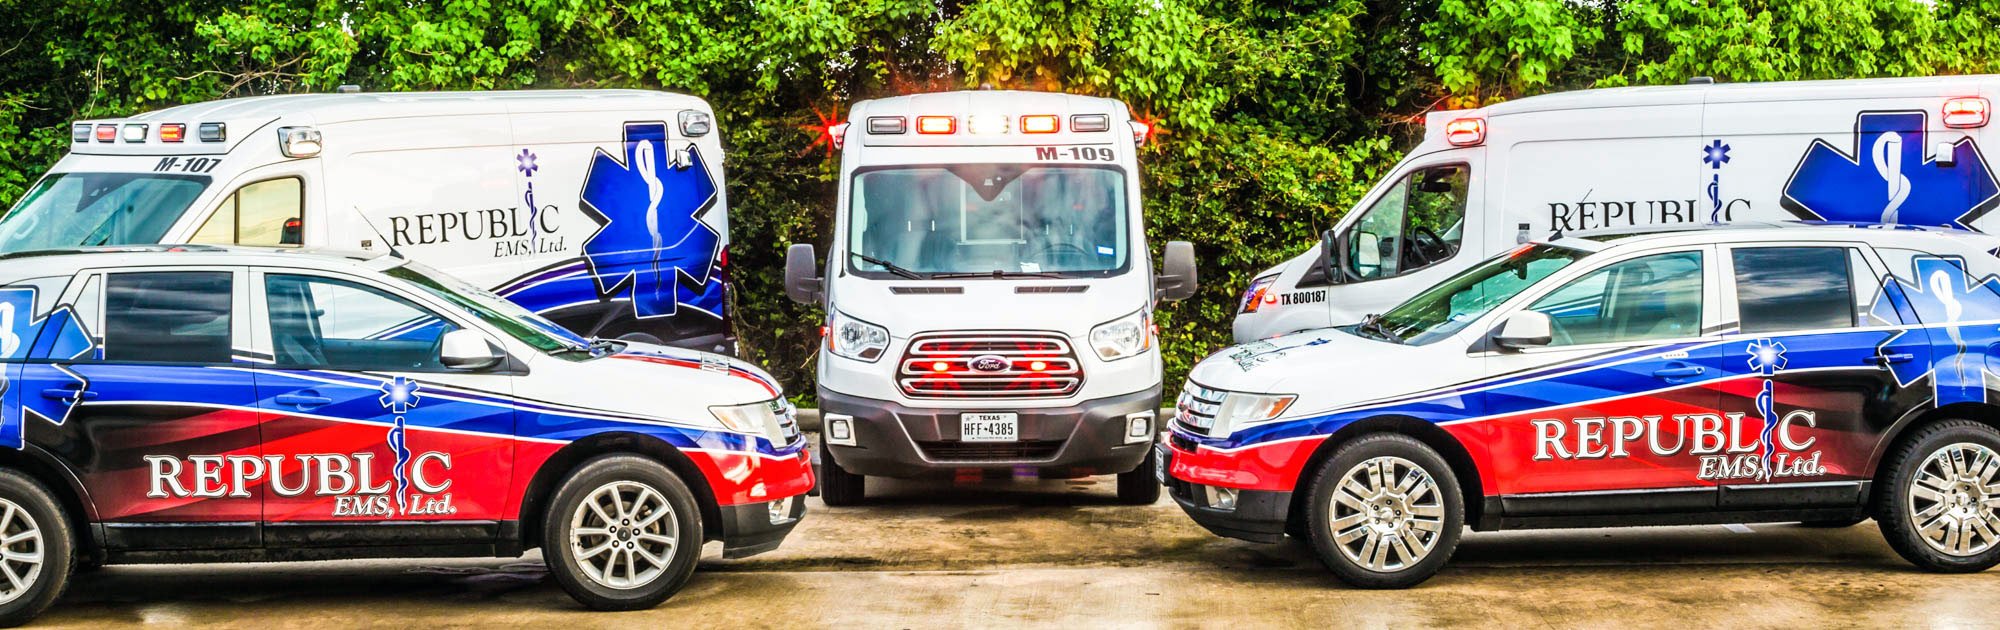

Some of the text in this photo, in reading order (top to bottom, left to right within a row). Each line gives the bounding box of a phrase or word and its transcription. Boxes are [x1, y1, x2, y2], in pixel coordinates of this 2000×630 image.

[1035, 147, 1115, 161] M-109
[153, 157, 222, 173] M-107
[539, 236, 567, 254] Ltd.
[1281, 290, 1326, 306] TX 800187
[978, 359, 1001, 369] Ford
[1697, 451, 1827, 480] EMS, Ltd.
[333, 494, 457, 518] EMS, Ltd.
